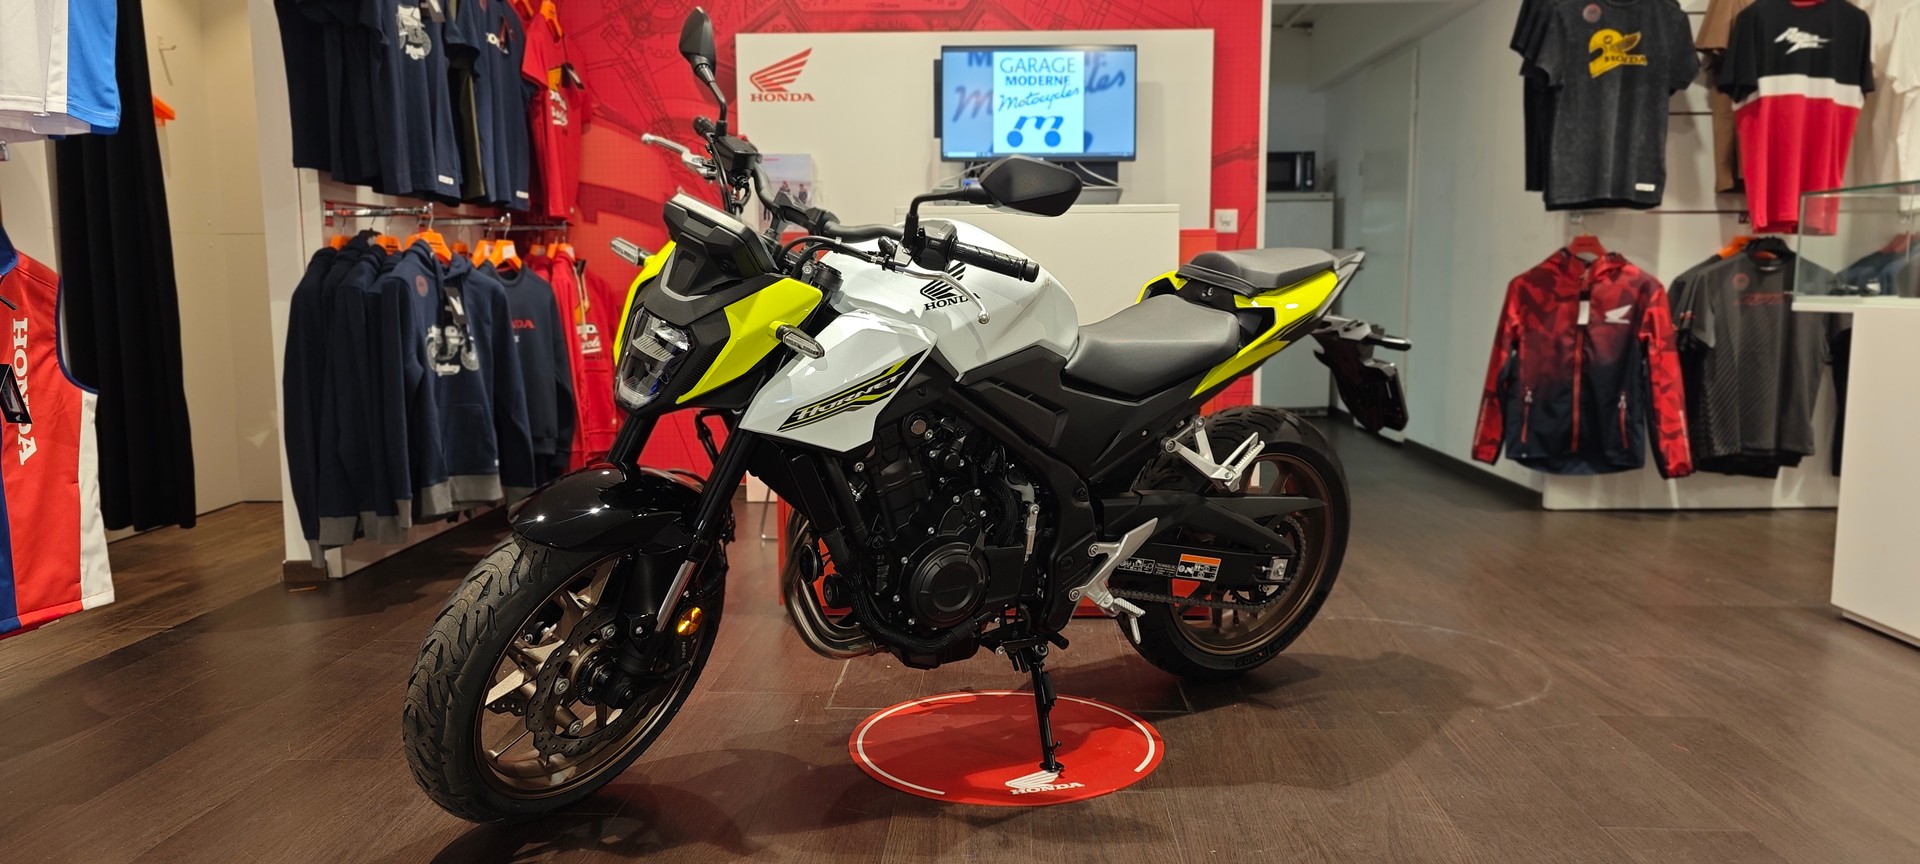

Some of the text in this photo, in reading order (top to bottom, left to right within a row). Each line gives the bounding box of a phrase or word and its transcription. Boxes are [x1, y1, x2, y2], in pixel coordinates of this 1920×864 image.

[1000, 57, 1076, 74] GARAGE
[1005, 75, 1070, 86] MODERNE
[750, 92, 815, 102] HONDA
[924, 292, 981, 311] HOND
[791, 370, 906, 421] HORNET
[1010, 782, 1086, 795] HONDA
